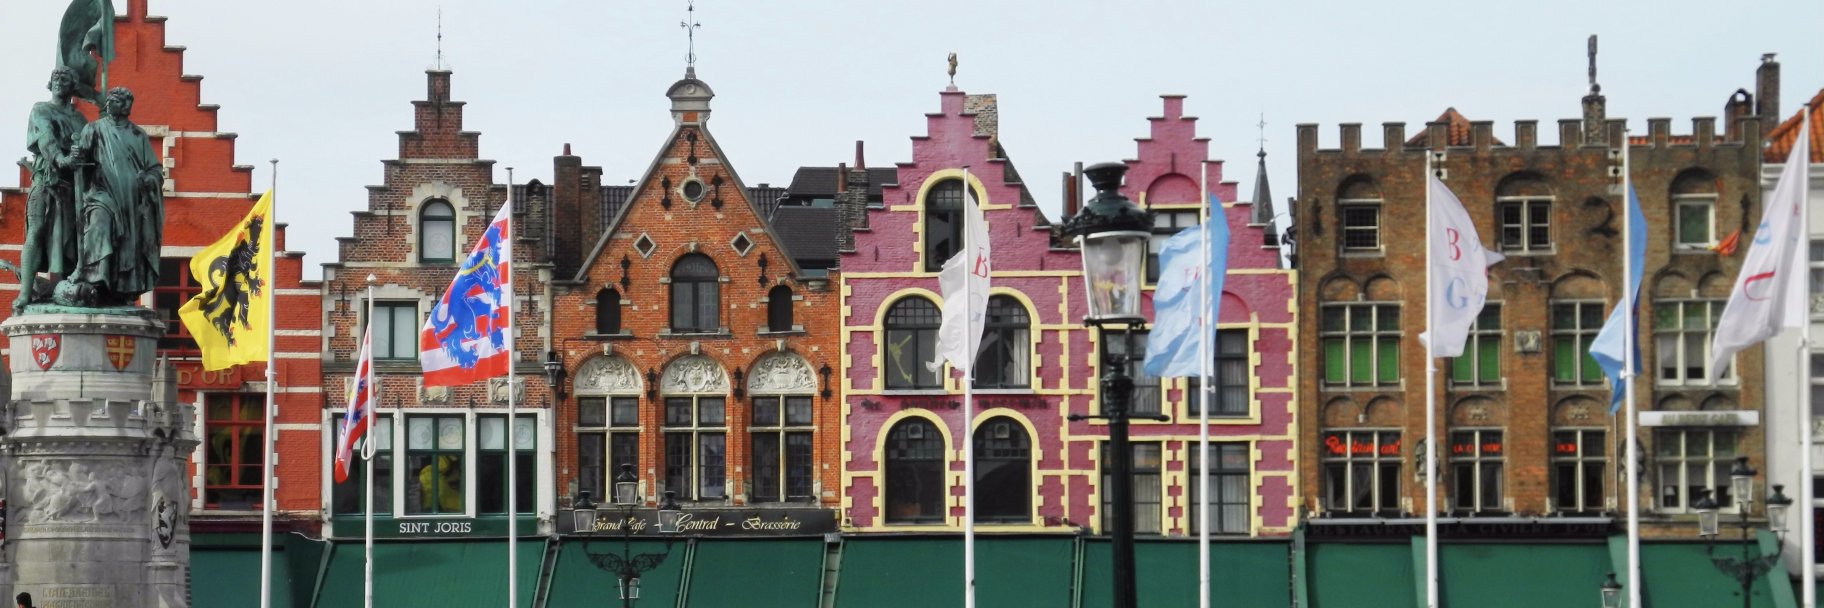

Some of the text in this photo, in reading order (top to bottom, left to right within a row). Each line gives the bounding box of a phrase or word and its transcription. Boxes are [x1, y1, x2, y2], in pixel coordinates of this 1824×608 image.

[1447, 228, 1461, 261] B
[1446, 277, 1468, 309] G
[399, 522, 472, 534] SINT JORIS
[674, 513, 720, 533] Central
[741, 517, 801, 531] Brasserie
